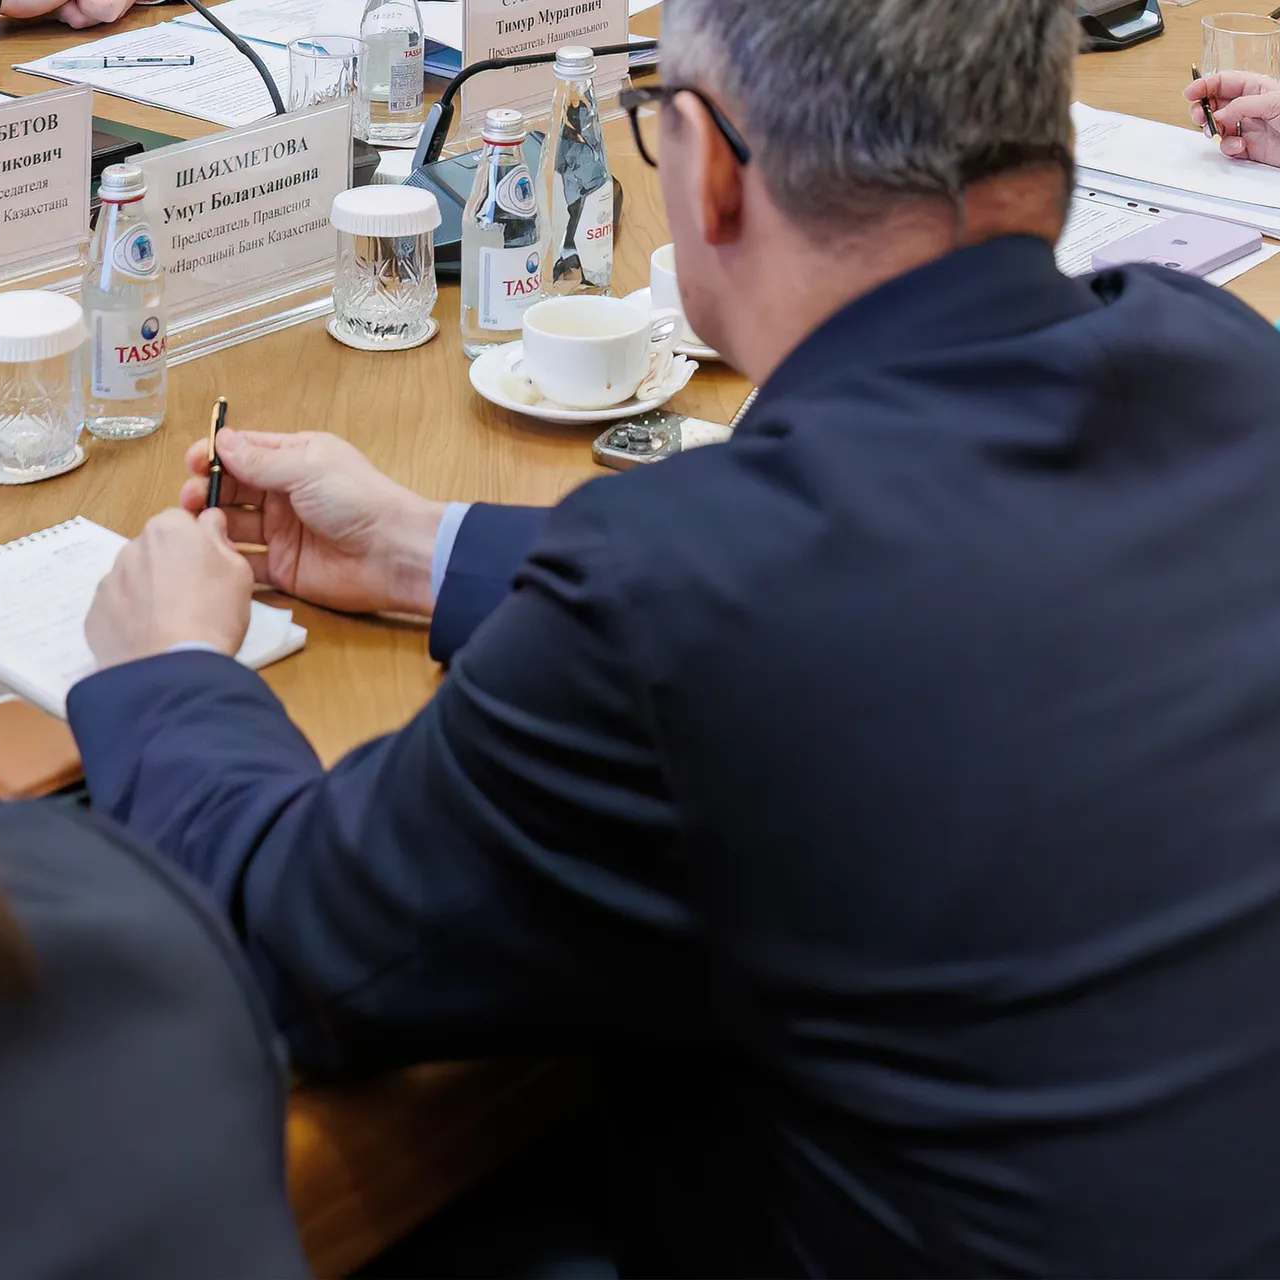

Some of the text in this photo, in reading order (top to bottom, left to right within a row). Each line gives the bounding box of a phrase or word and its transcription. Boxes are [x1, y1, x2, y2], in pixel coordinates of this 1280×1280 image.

[496, 0, 602, 35] Тимур Муратович
[488, 20, 609, 60] Председатель Национального
[176, 136, 309, 188] ШАЯХМЕТОВА
[3, 197, 68, 223] Казахстана
[163, 167, 318, 224] Умут Болатхановна
[172, 198, 311, 250] Председатель Правления
[169, 244, 235, 275] «Народный
[239, 237, 265, 255] Банк
[503, 273, 541, 297] TASS
